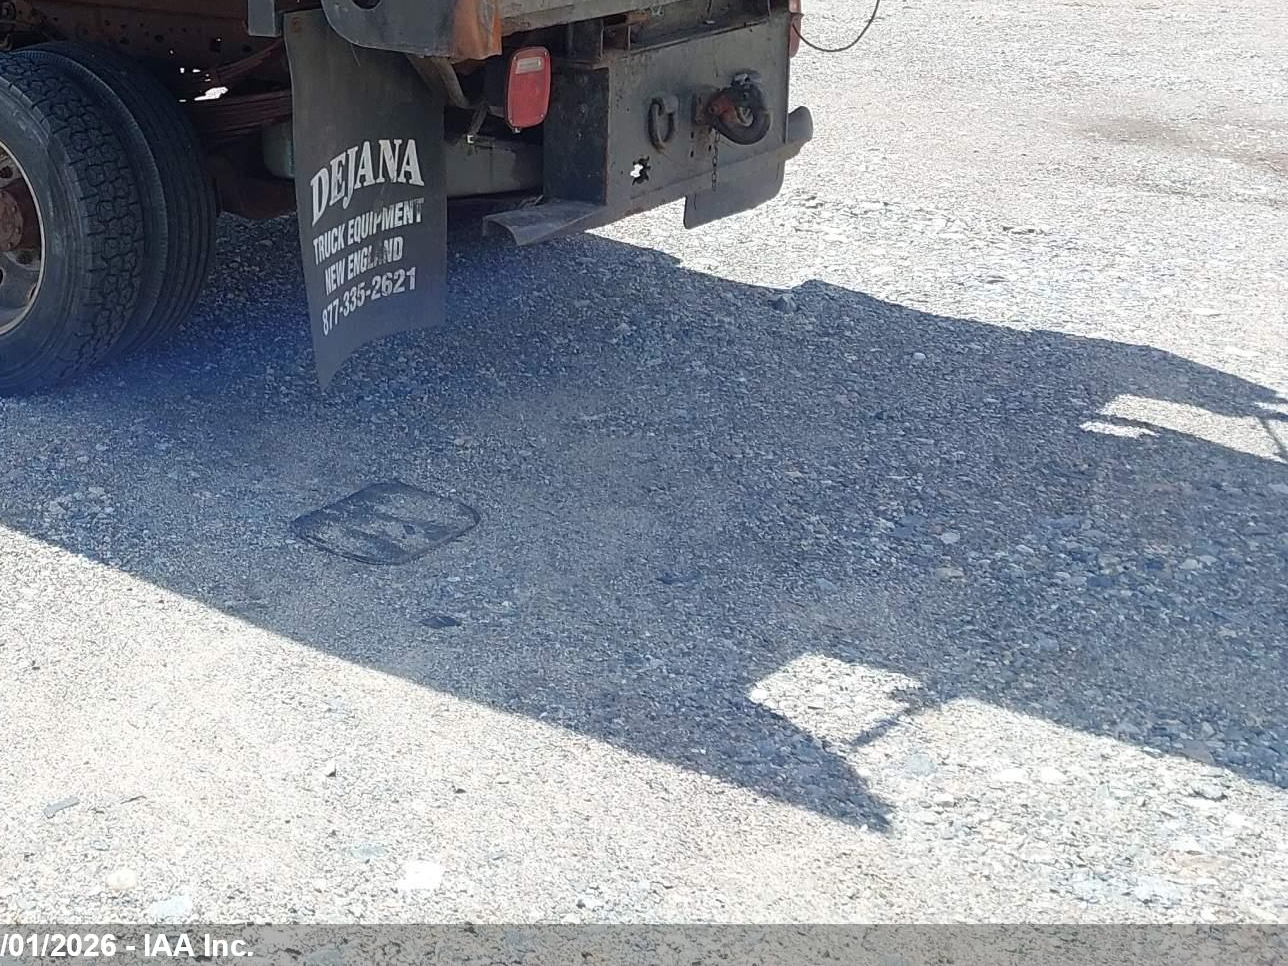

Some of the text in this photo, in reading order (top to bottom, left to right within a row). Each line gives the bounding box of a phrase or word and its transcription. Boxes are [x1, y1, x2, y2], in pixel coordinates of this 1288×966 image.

[310, 139, 425, 227] DEJANA
[313, 197, 425, 266] TRUCK EQUIPMENT
[322, 266, 417, 337] 877-335-2621
[324, 251, 345, 296] NEW
